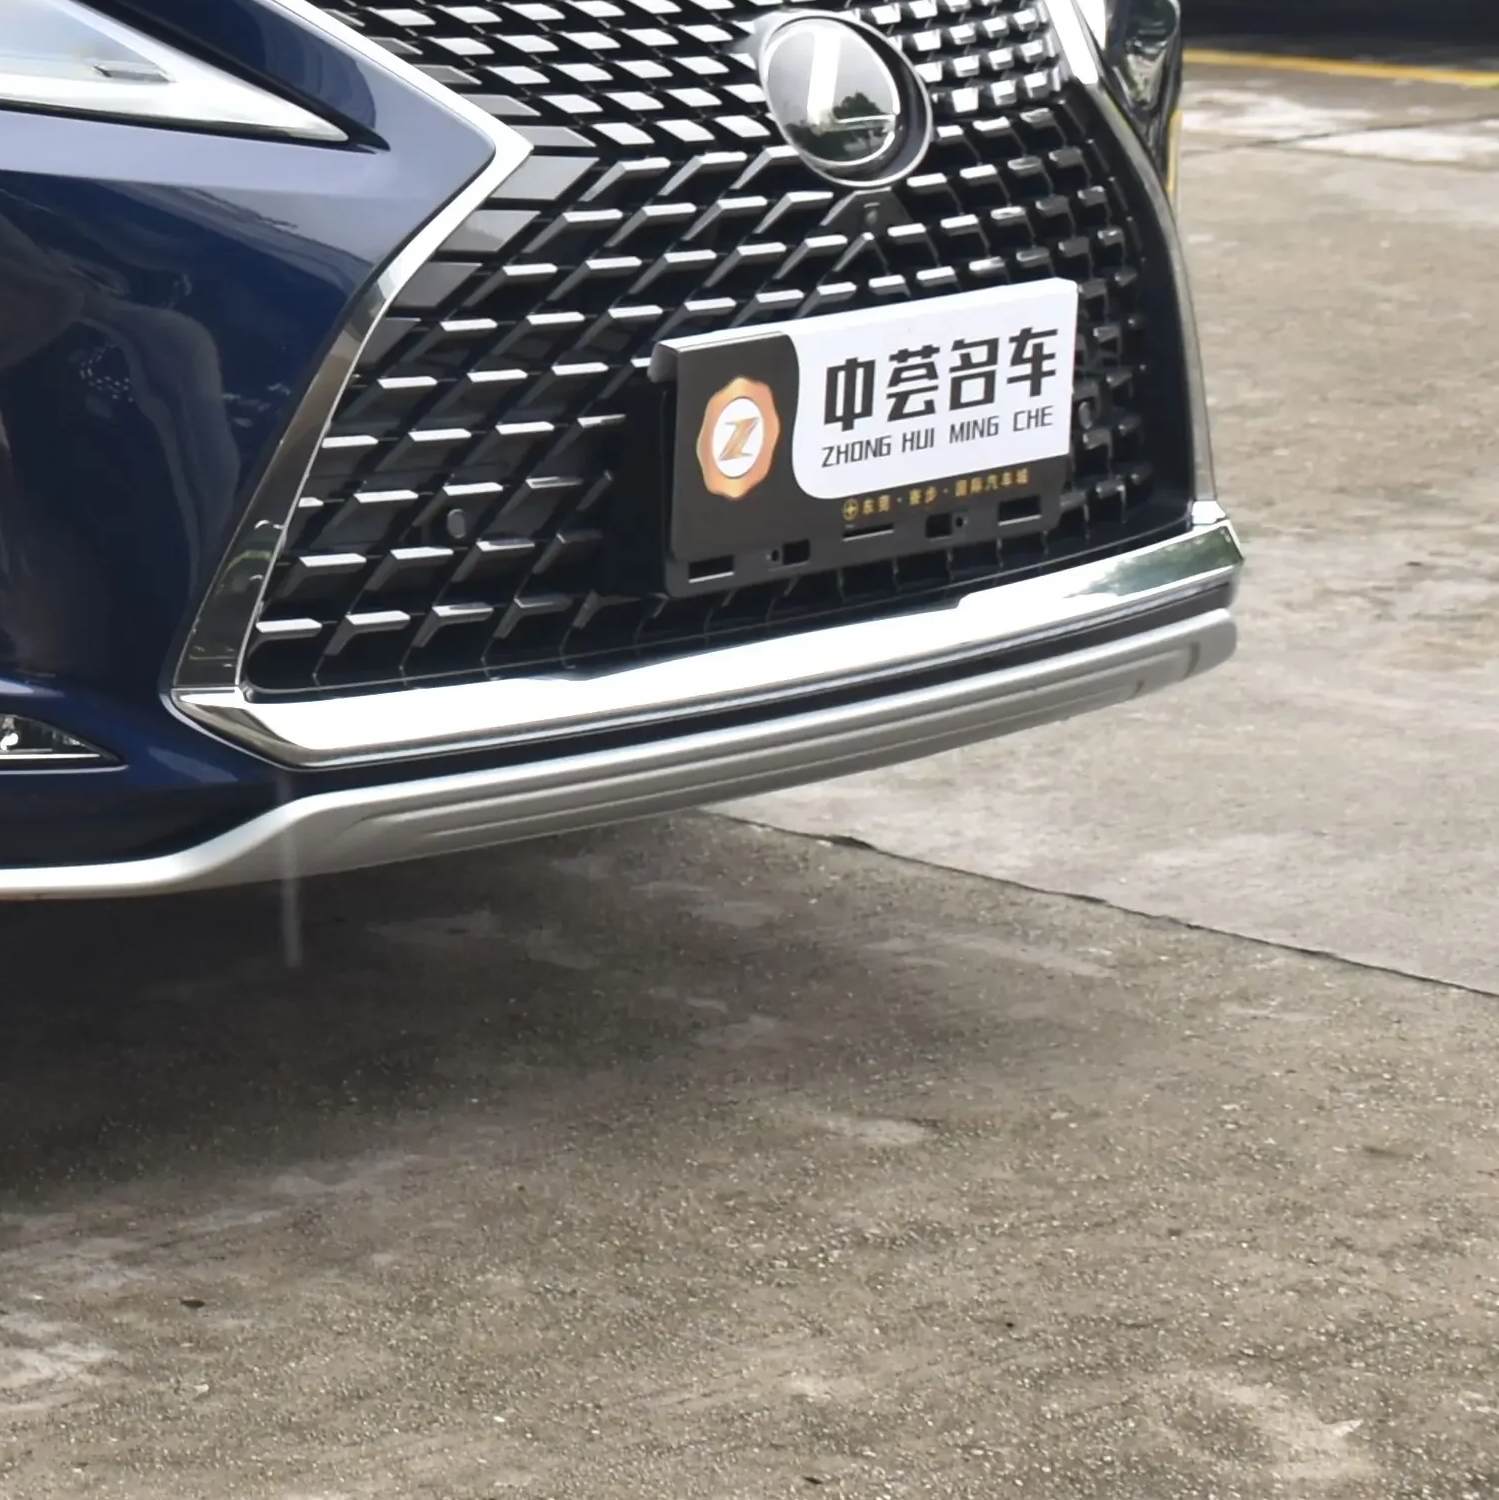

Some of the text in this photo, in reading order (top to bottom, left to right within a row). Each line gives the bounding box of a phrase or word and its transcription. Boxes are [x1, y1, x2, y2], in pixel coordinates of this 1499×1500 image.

[823, 327, 1058, 432] 中荟名车
[821, 405, 1054, 468] ZHONG HUI MING CHE
